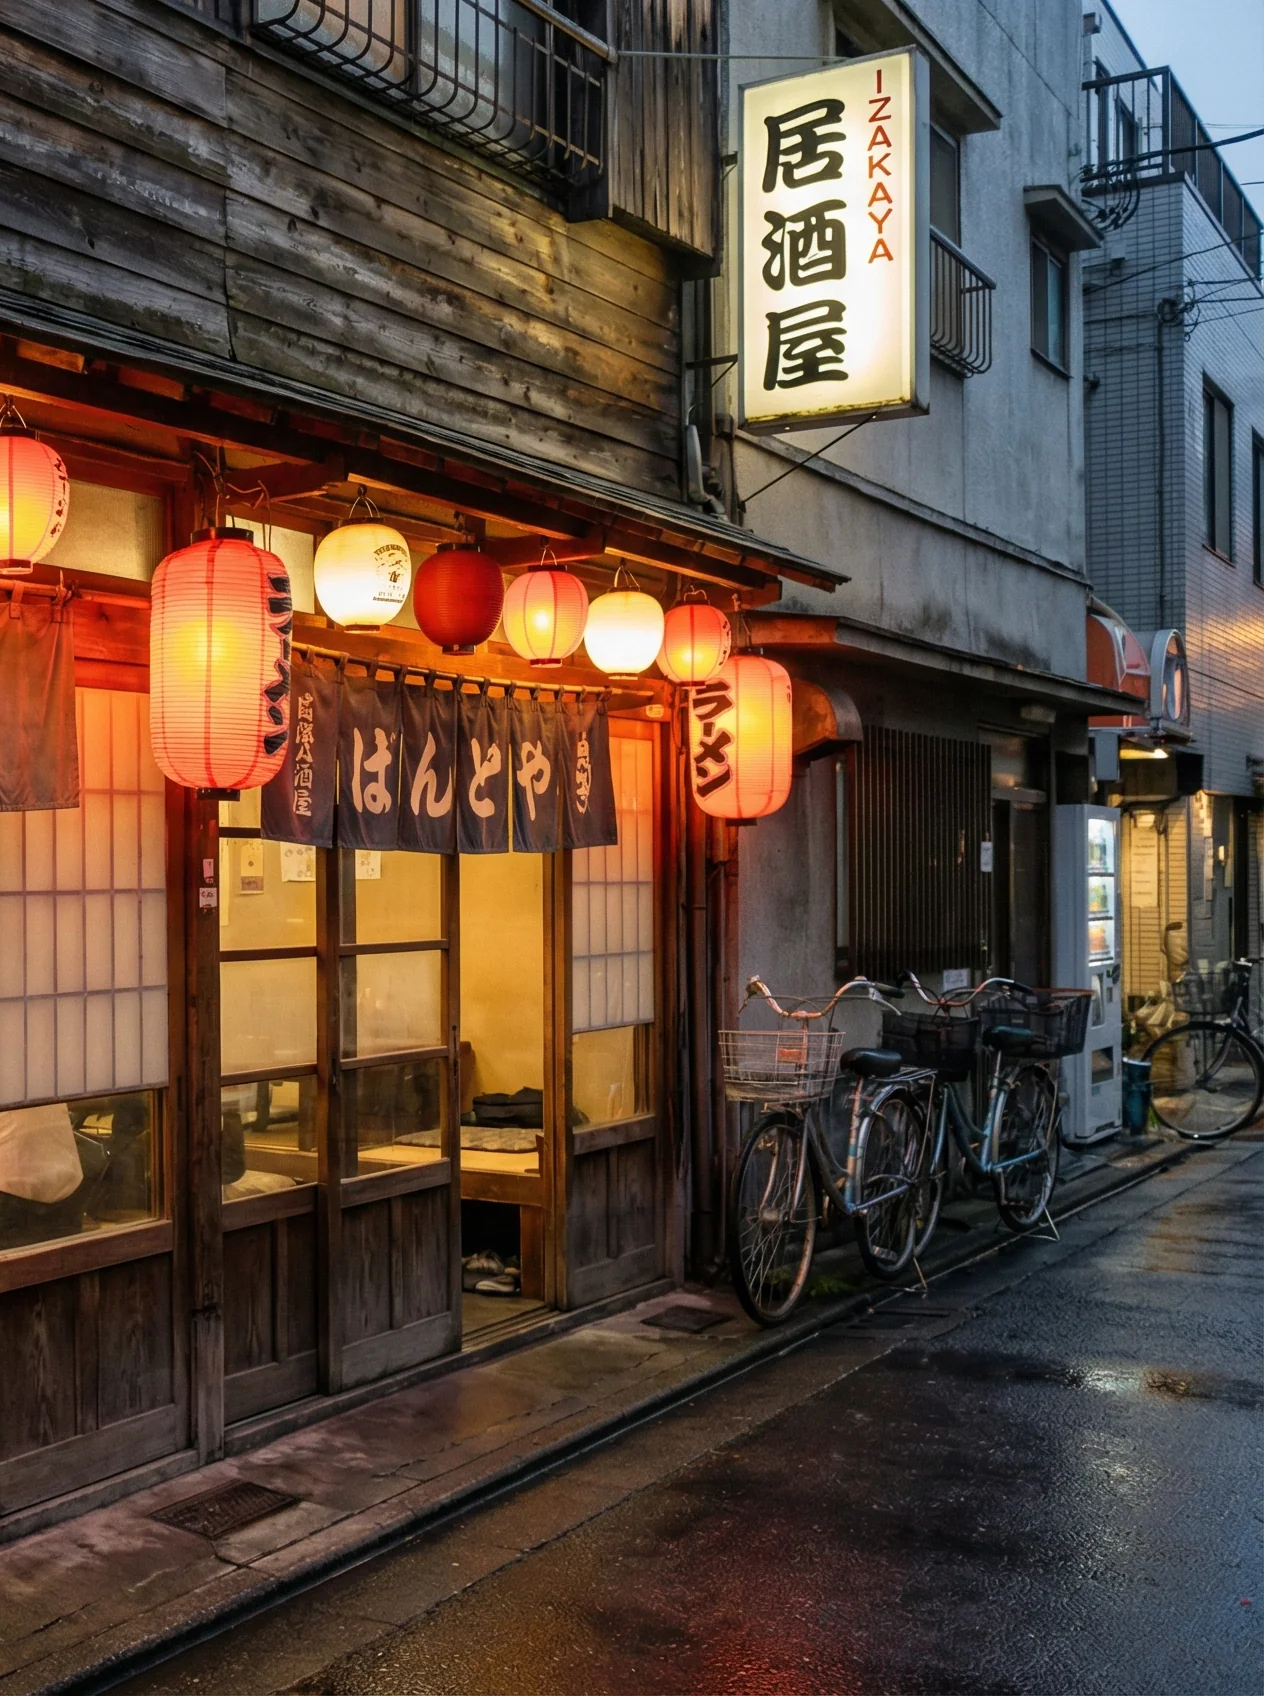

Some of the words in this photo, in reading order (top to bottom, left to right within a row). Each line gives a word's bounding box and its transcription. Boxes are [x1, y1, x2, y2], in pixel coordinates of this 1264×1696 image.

[761, 98, 849, 391] 居酒屋
[867, 69, 894, 264] IZAKAYA
[691, 679, 734, 800] ラーメン
